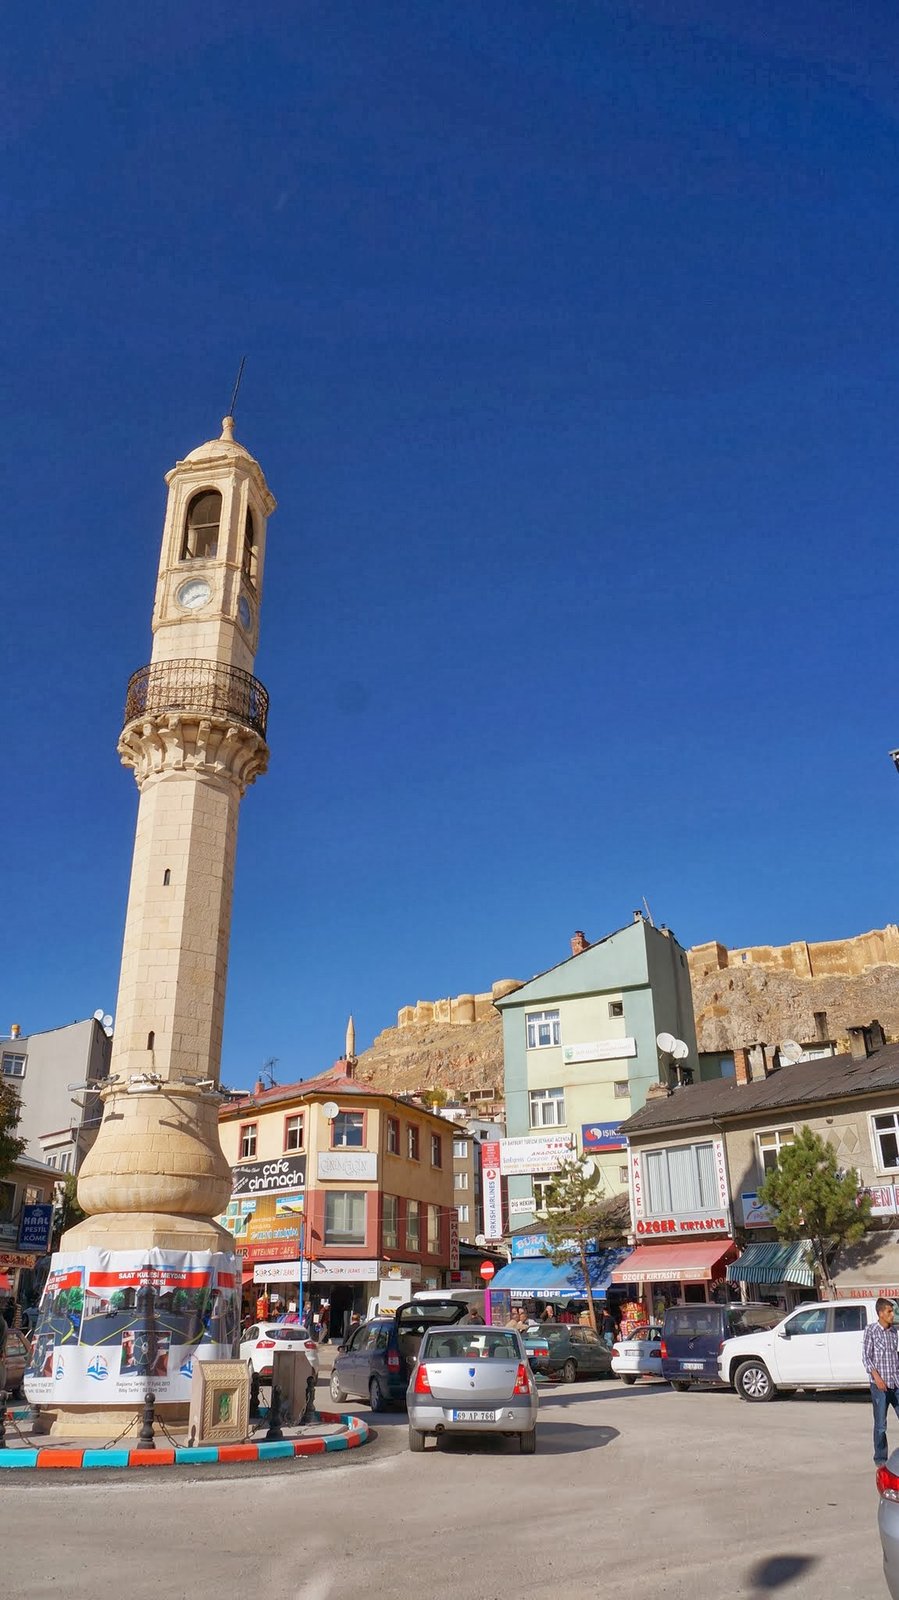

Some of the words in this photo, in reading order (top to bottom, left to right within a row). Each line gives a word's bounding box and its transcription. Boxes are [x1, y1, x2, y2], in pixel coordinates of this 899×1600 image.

[633, 1158, 642, 1206] KAŞE
[637, 1219, 677, 1234] ÖZGER
[680, 1218, 726, 1232] KIRTASİYE
[23, 1233, 46, 1242] KÖME
[516, 1236, 545, 1249] BURA
[511, 1290, 534, 1298] URAK
[537, 1289, 560, 1298] BÜFE
[457, 1412, 466, 1420] 69
[469, 1412, 478, 1420] AP
[481, 1412, 494, 1420] 766
